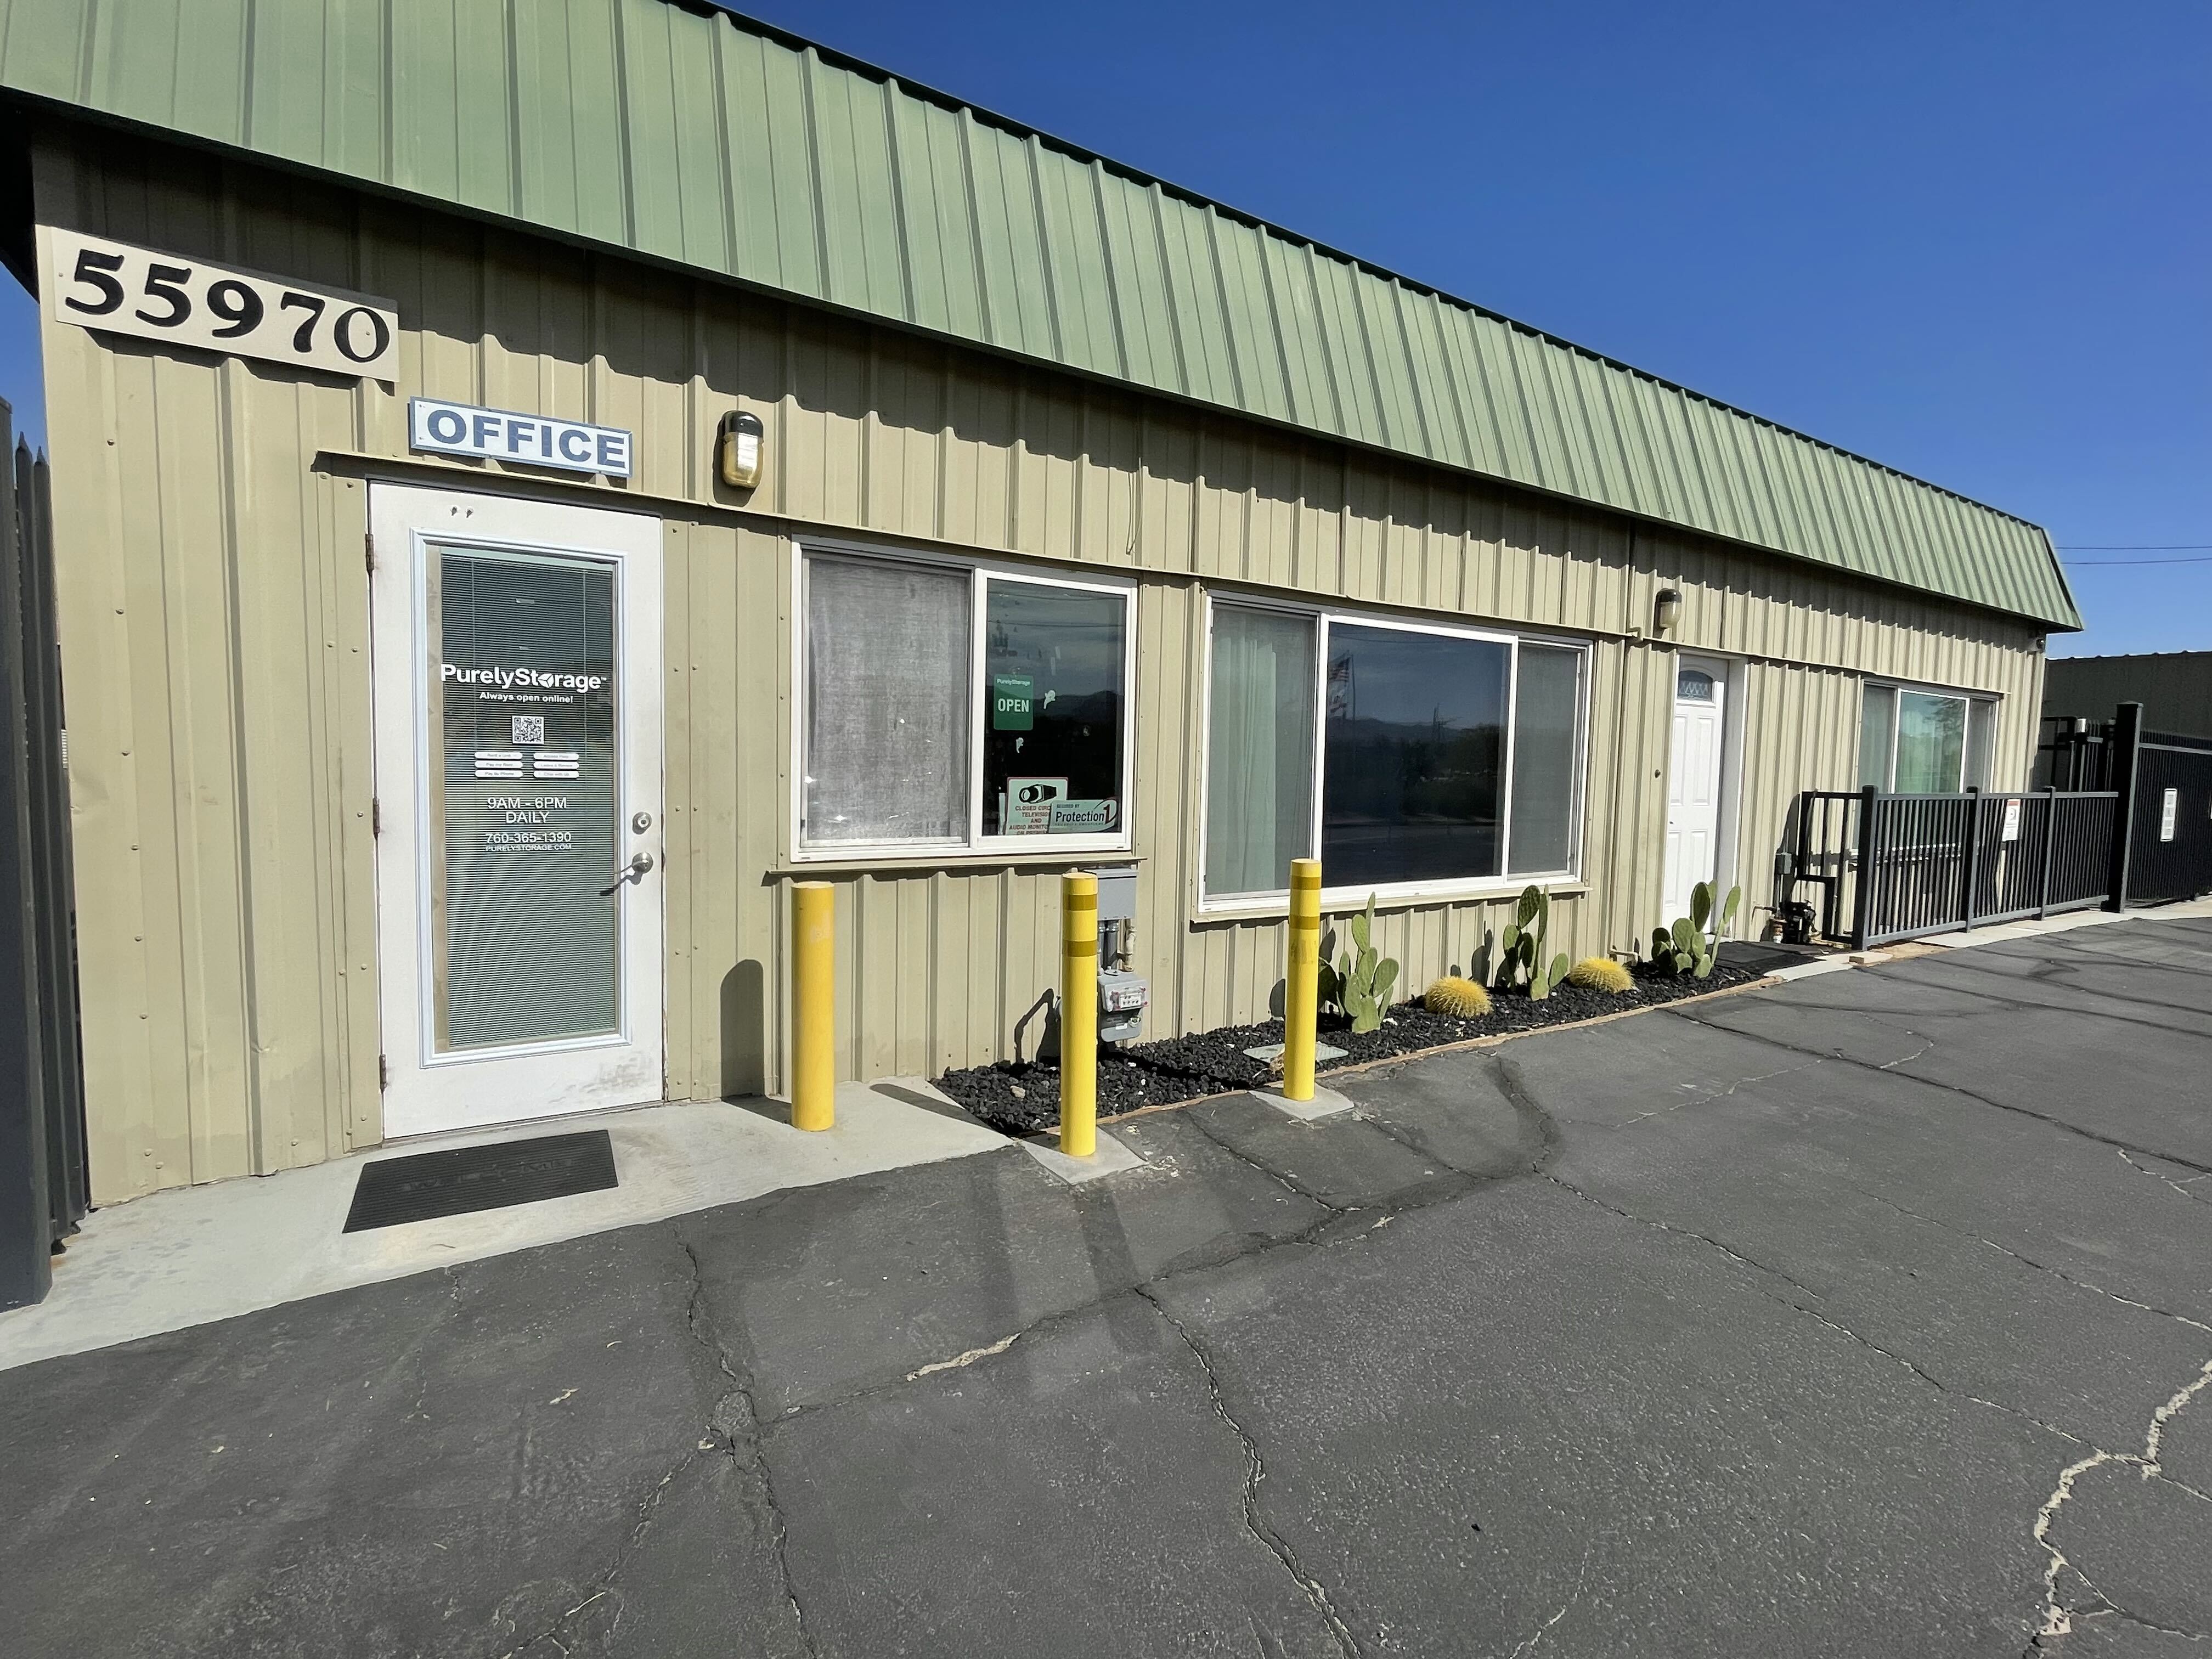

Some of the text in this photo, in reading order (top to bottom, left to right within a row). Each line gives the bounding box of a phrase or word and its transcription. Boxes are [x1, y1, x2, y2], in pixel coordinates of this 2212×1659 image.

[65, 249, 390, 363] 55970
[427, 409, 625, 469] OFFICE
[479, 692, 517, 702] Always
[517, 695, 540, 703] open
[998, 698, 1029, 712] OPEN
[488, 797, 521, 809] 9AM
[535, 797, 567, 809] 6PM
[506, 811, 550, 823] DAILY
[1056, 811, 1104, 822] Protection
[486, 832, 572, 843] 760-365-1390
